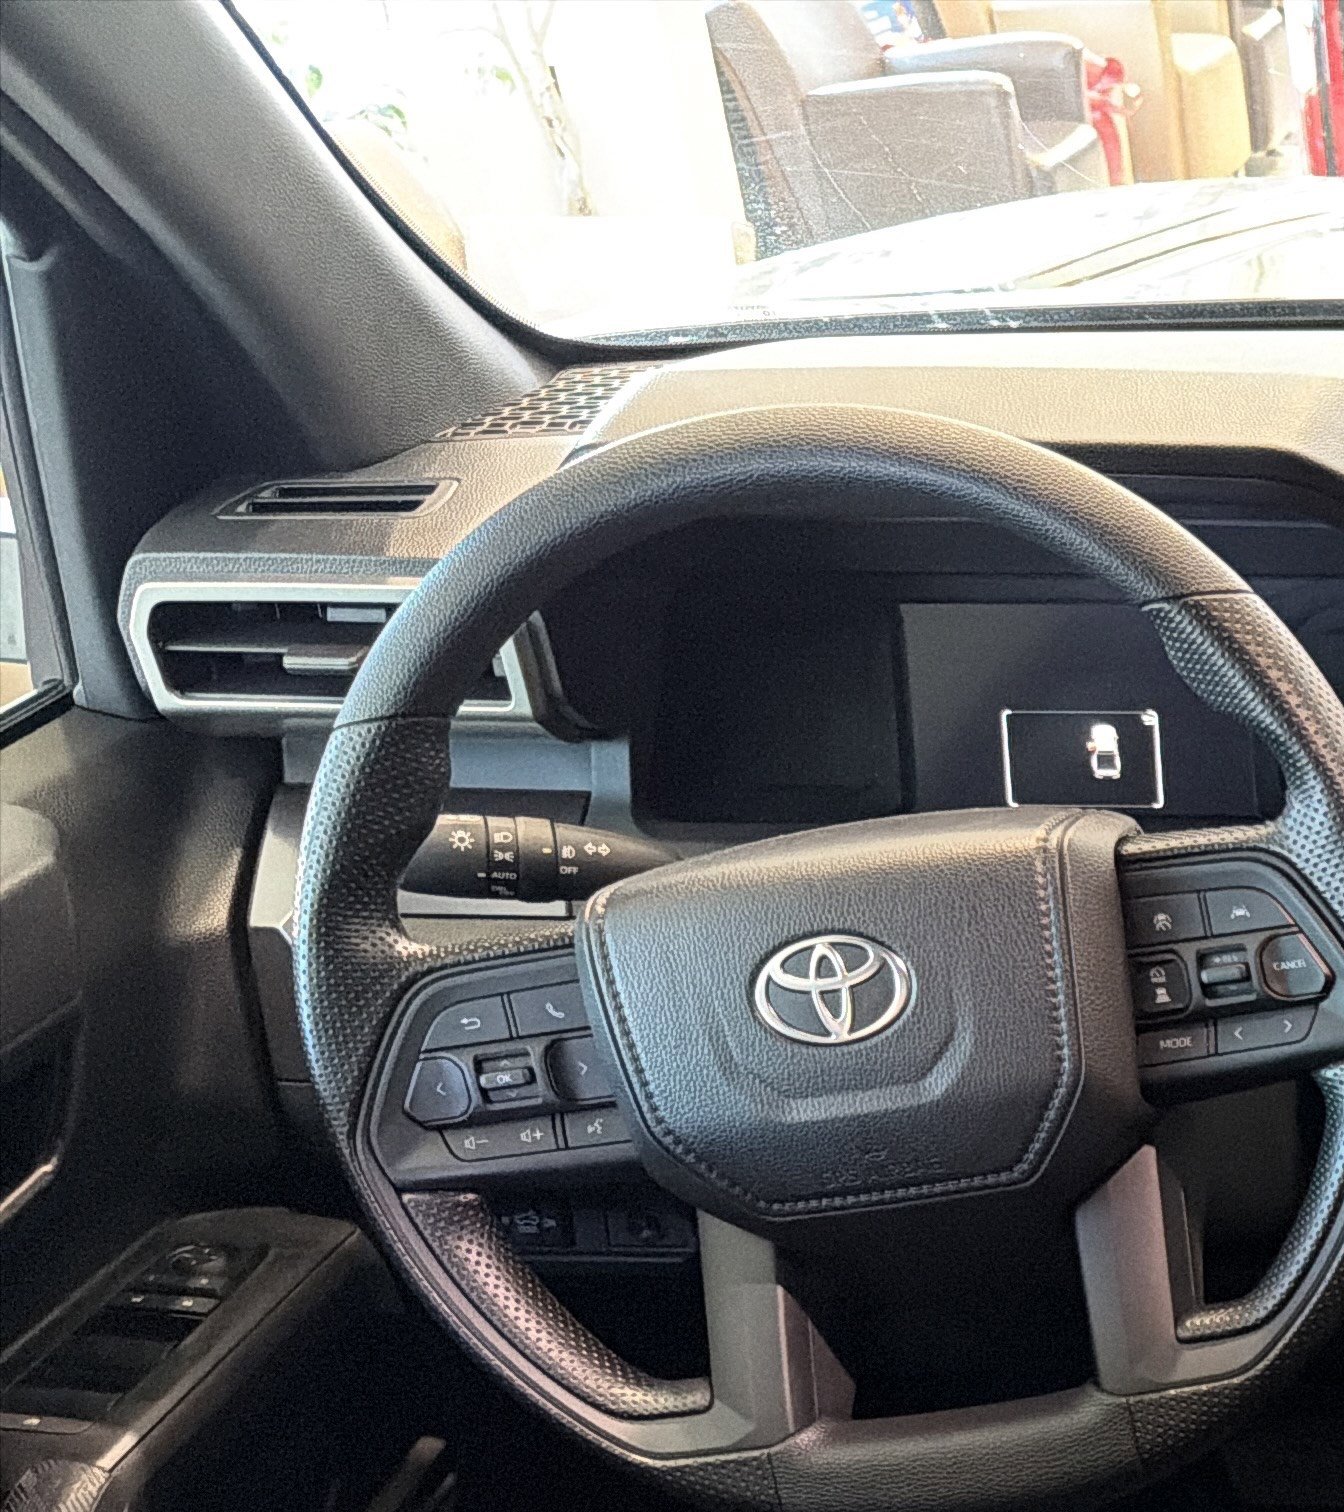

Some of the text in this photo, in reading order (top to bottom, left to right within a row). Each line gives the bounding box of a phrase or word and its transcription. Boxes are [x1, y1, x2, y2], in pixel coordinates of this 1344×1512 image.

[491, 871, 518, 880] AUTO
[559, 866, 579, 875] OFF
[1273, 959, 1307, 971] CANCEL
[1159, 1036, 1193, 1049] MODE
[497, 1073, 513, 1085] OK
